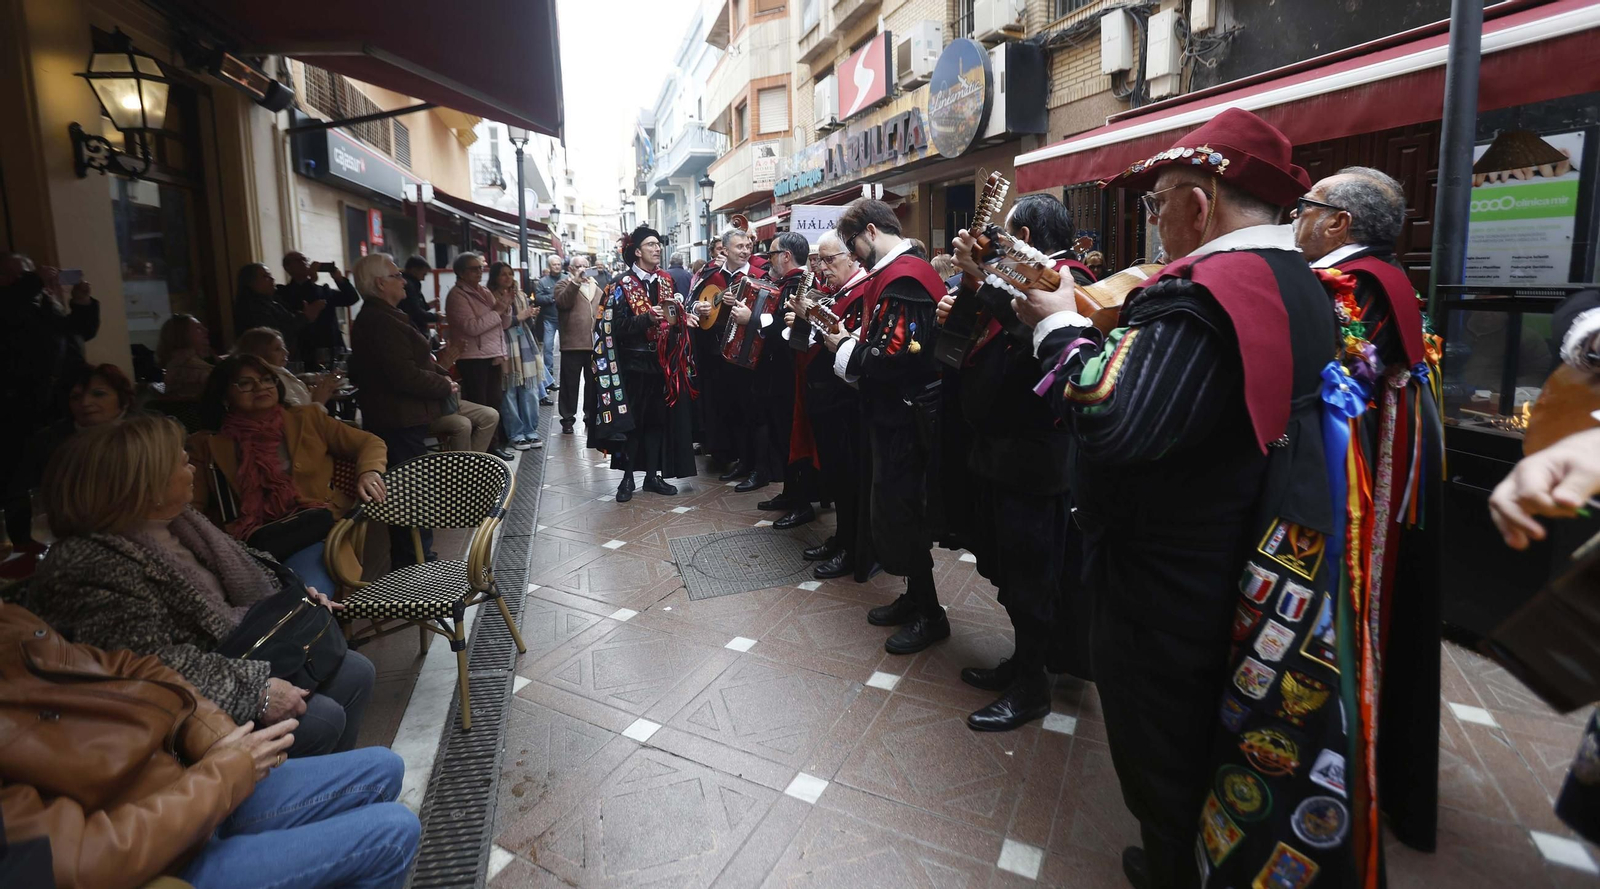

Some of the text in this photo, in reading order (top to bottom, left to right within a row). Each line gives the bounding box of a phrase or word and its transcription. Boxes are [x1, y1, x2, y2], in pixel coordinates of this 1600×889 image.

[824, 107, 928, 180] LA RULETA
[796, 217, 837, 230] MÁLA
